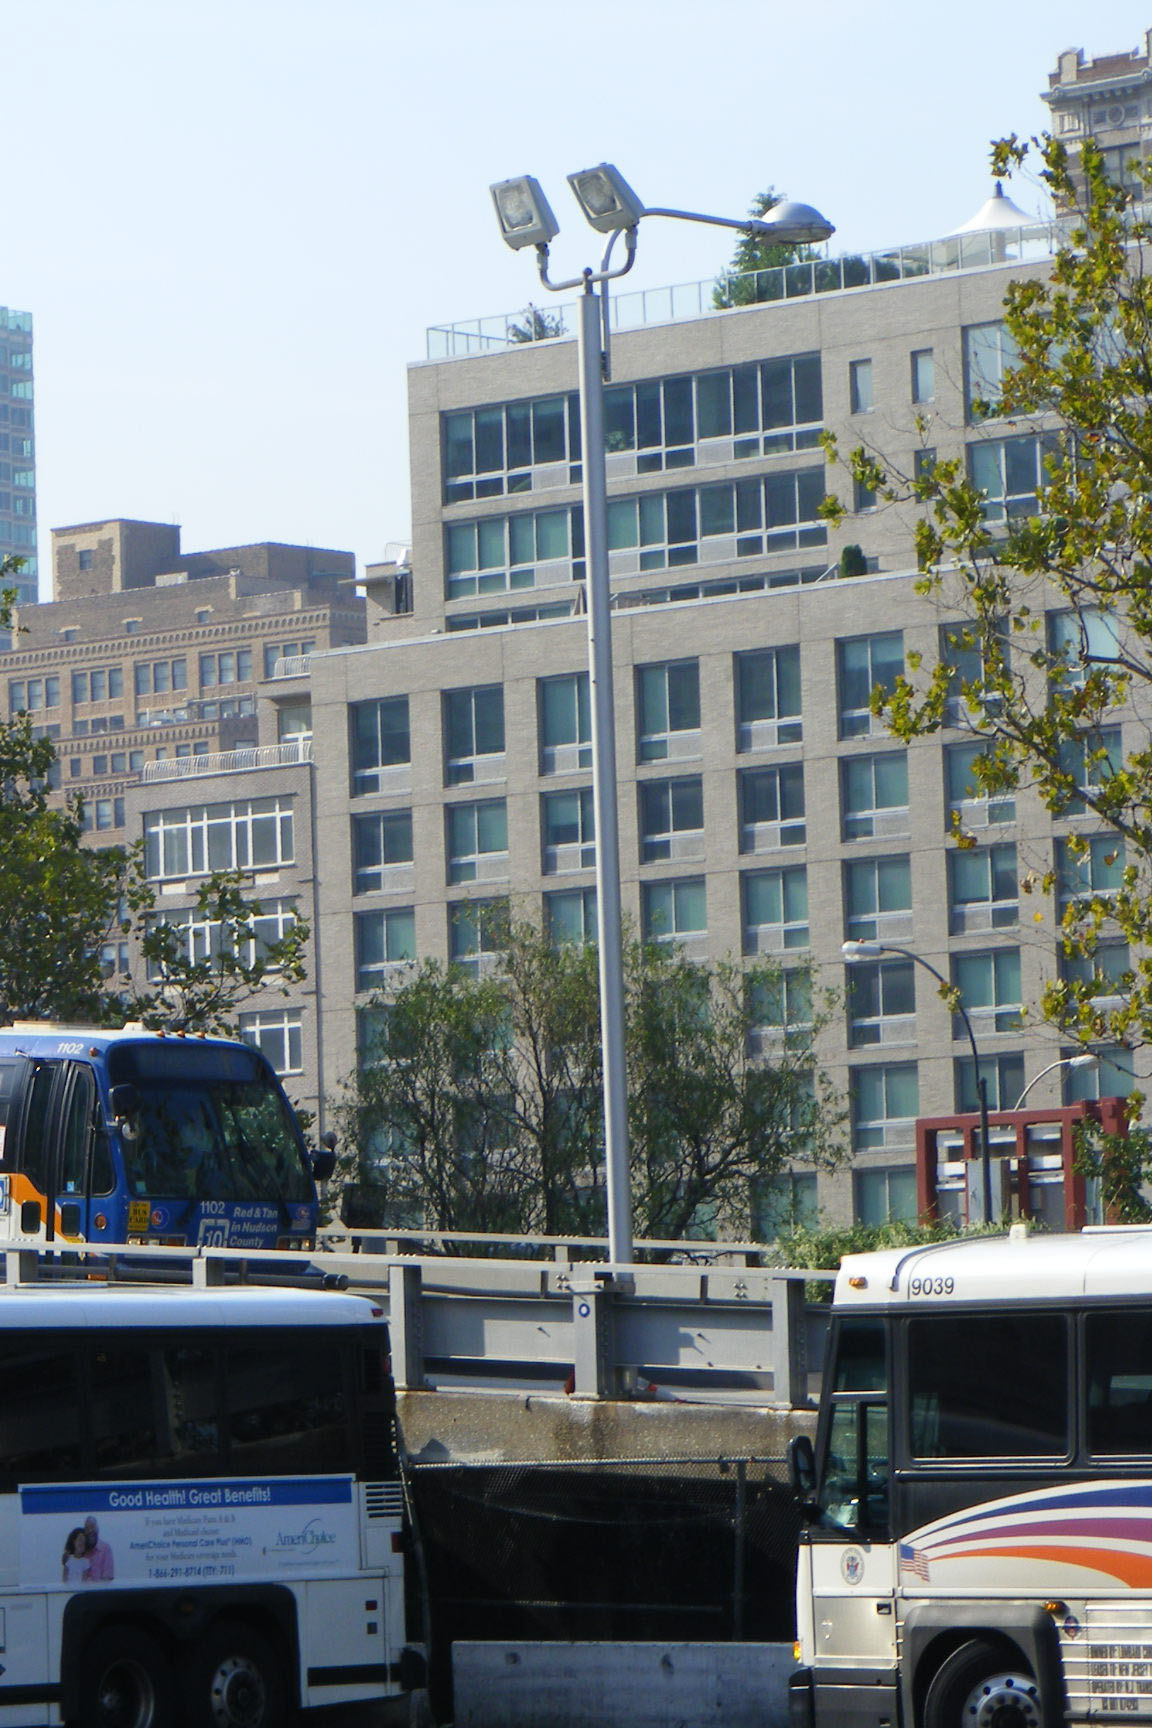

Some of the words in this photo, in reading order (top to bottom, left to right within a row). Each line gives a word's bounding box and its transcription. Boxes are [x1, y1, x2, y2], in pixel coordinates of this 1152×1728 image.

[57, 1042, 85, 1055] 1102
[200, 1201, 225, 1214] 1102
[233, 1207, 254, 1218] Red
[254, 1208, 261, 1218] &
[262, 1208, 278, 1218] Tan
[232, 1221, 241, 1232] in
[242, 1221, 278, 1232] Hudson
[205, 1231, 223, 1248] 10
[229, 1236, 264, 1248] County
[912, 1277, 954, 1295] 9039
[109, 1491, 142, 1507] Good
[146, 1490, 186, 1506] Health!
[189, 1489, 222, 1504] Great
[224, 1487, 271, 1503] Benefits!
